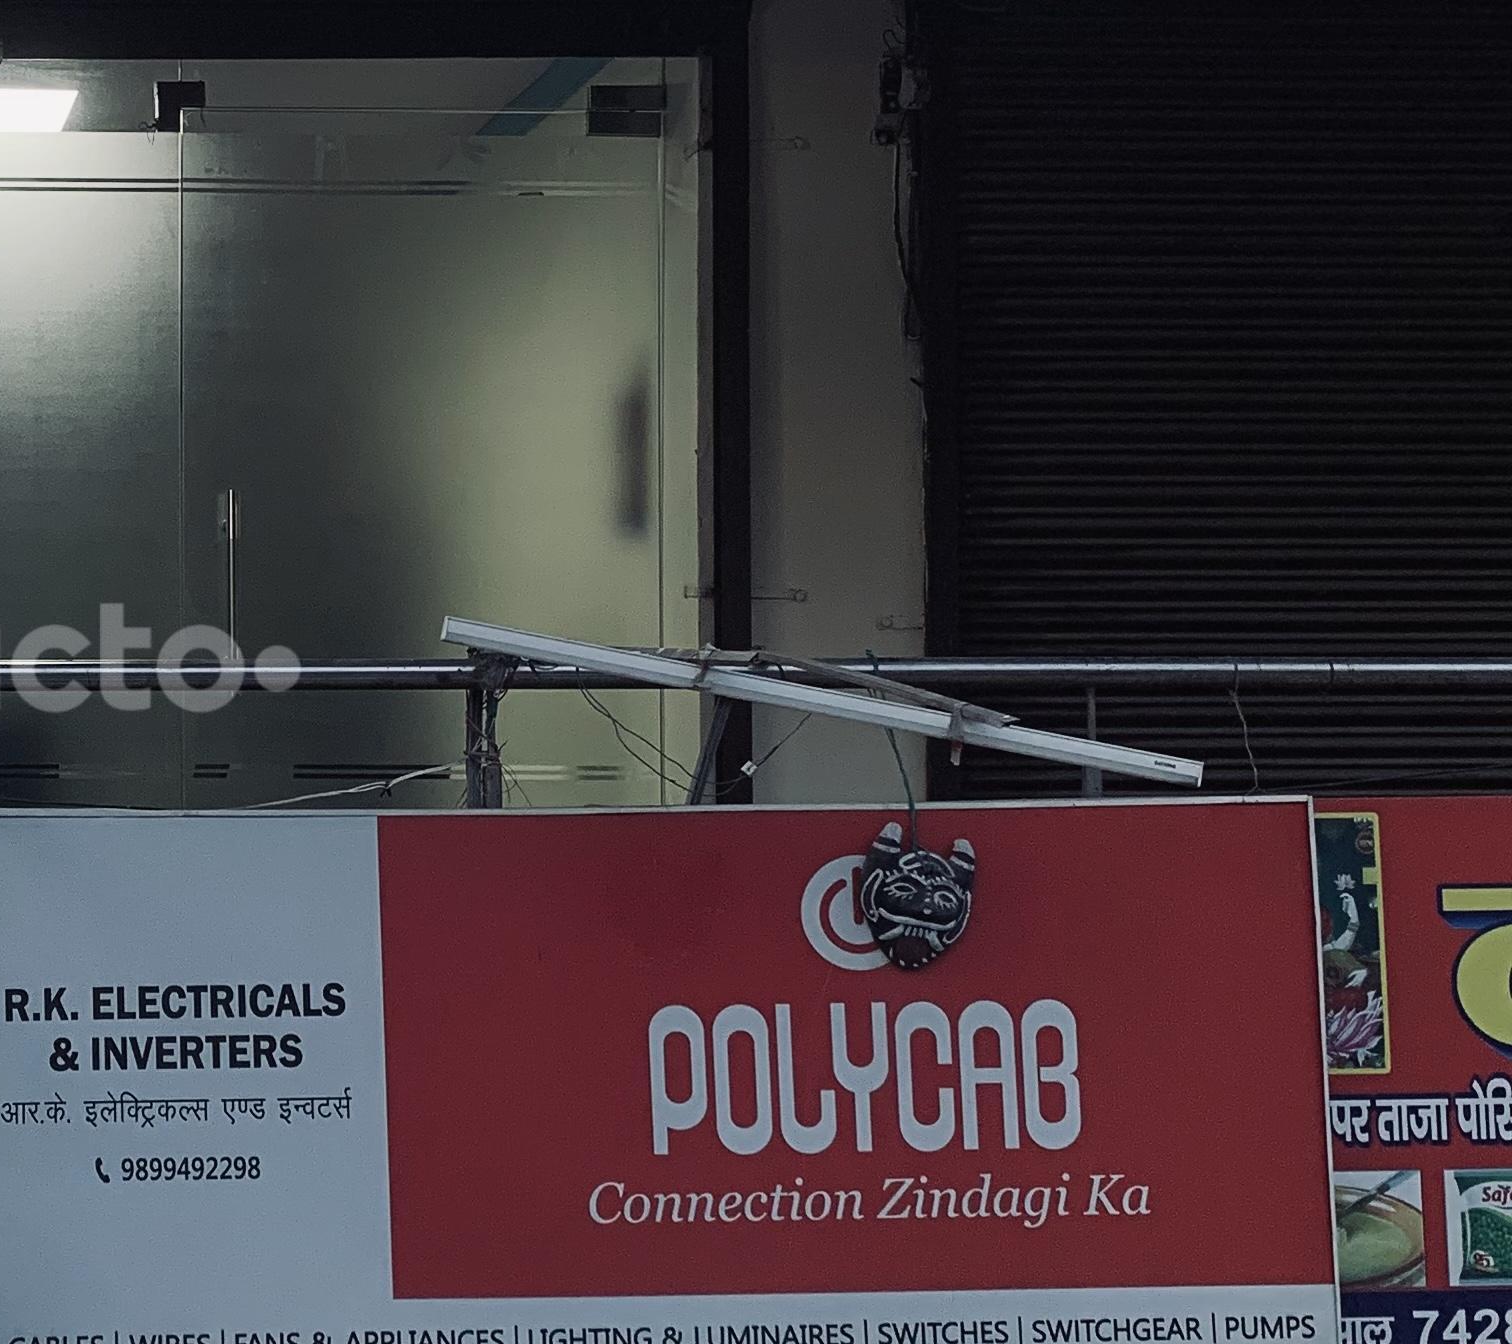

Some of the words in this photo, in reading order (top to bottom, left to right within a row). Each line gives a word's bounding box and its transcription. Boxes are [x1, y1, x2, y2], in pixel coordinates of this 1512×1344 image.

[3, 986, 80, 1024] R.K.
[92, 982, 347, 1022] ELECTRICALS
[48, 1037, 80, 1072] &
[92, 1033, 304, 1072] INVERTERS
[648, 998, 1082, 1156] POLYCAB
[0, 1093, 71, 1125] आर.के.
[84, 1090, 209, 1128] इलेक्ट्रिकल्स
[221, 1097, 266, 1124] एण्ड
[277, 1087, 353, 1124] इन्वटर्स
[1375, 1097, 1449, 1142] ताजा
[121, 1156, 261, 1181] 9899492298
[588, 1179, 864, 1226] Connection
[877, 1173, 1070, 1229] Zindagi
[1085, 1173, 1153, 1218] Ka
[1224, 1313, 1317, 1343] PUMPS
